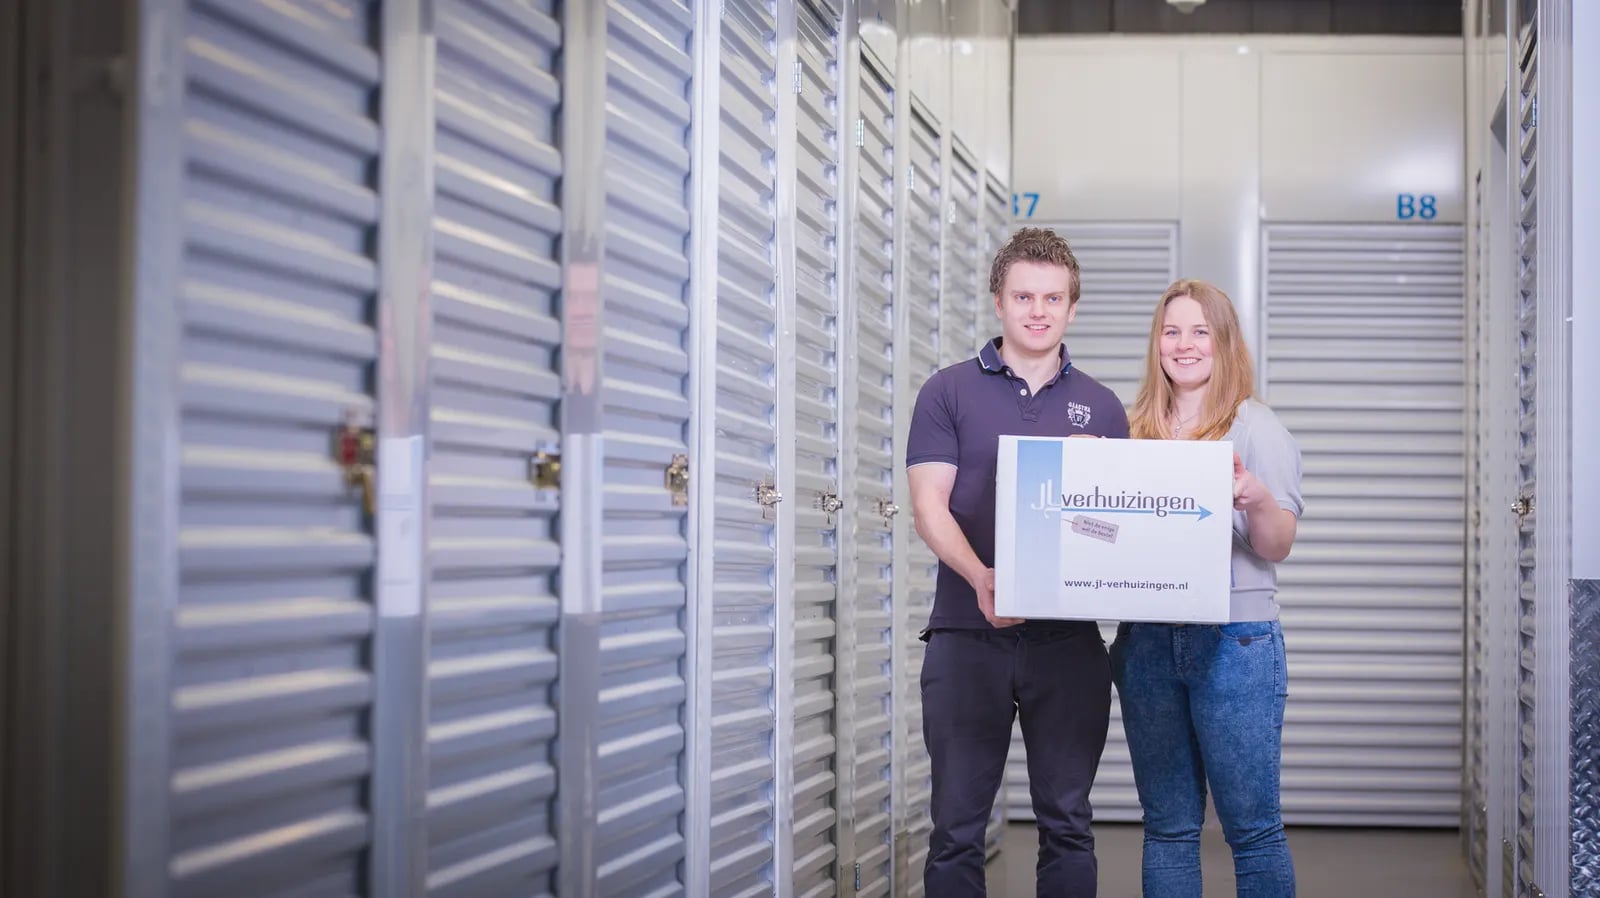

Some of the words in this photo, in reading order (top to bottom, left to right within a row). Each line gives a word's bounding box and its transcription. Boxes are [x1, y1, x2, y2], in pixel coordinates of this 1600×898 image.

[1397, 193, 1437, 219] B8
[1061, 486, 1195, 517] verhuizingen
[1064, 579, 1188, 591] www.jl-verhuizingen.nl
